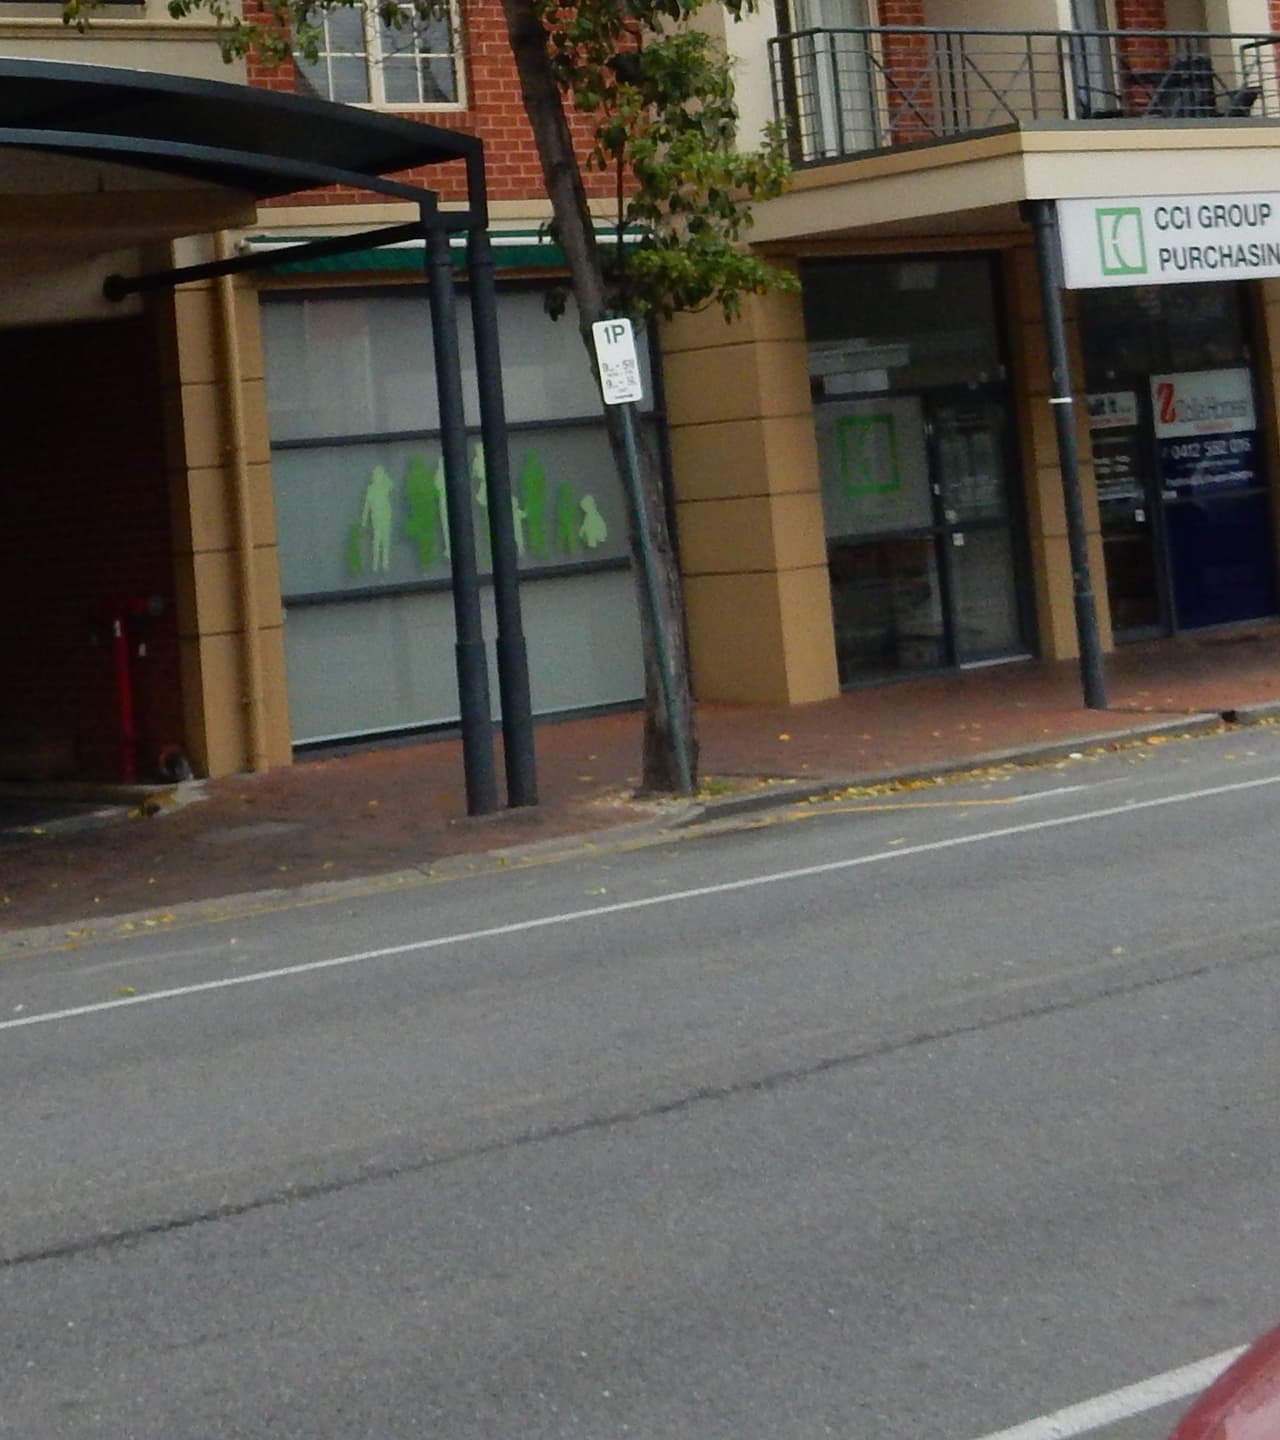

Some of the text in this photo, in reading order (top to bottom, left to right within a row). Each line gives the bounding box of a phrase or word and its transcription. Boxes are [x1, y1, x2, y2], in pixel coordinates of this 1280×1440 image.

[1154, 203, 1272, 231] CCI GROUP
[604, 324, 625, 345] 1P
